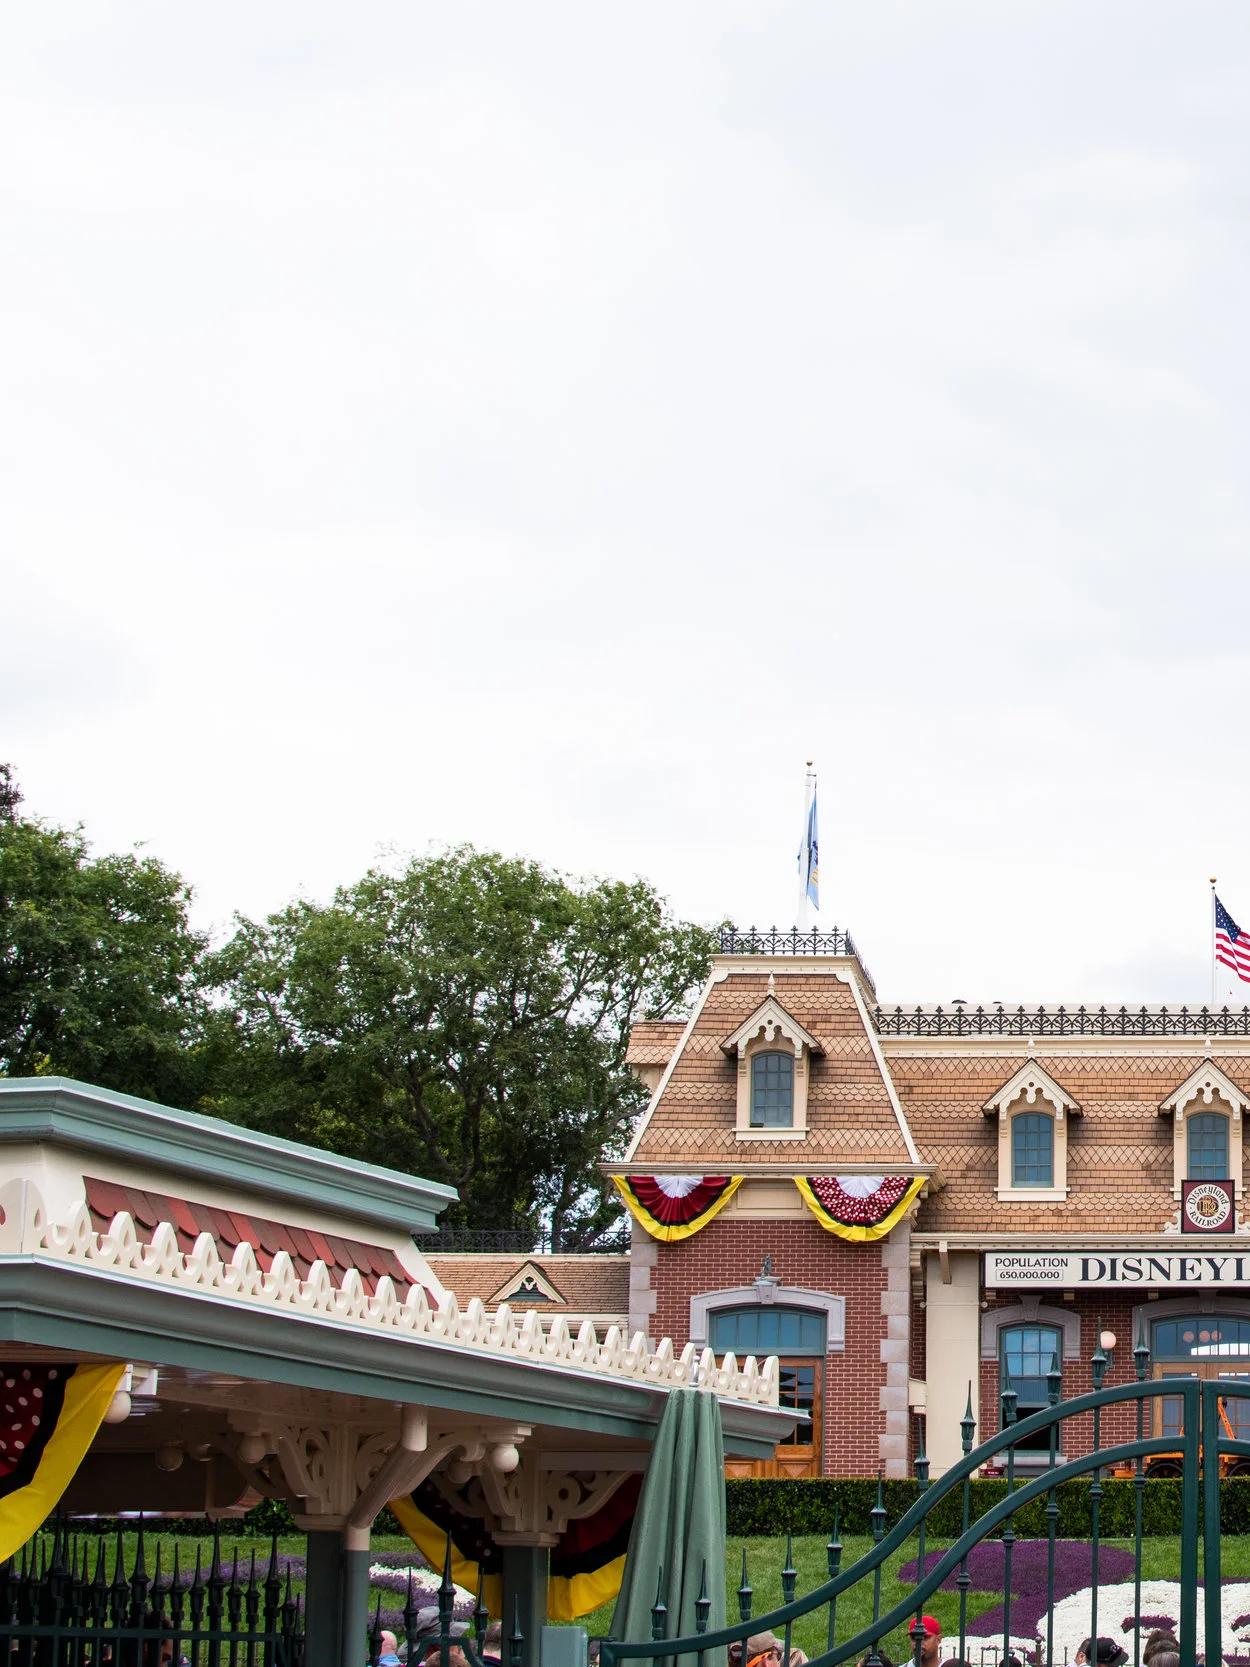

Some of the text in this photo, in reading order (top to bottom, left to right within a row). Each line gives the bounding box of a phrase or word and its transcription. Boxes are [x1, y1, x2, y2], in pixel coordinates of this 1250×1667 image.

[1187, 1186, 1229, 1205] Disneyland
[1190, 1211, 1226, 1226] RAILROAD
[995, 1258, 1068, 1267] POPULATION
